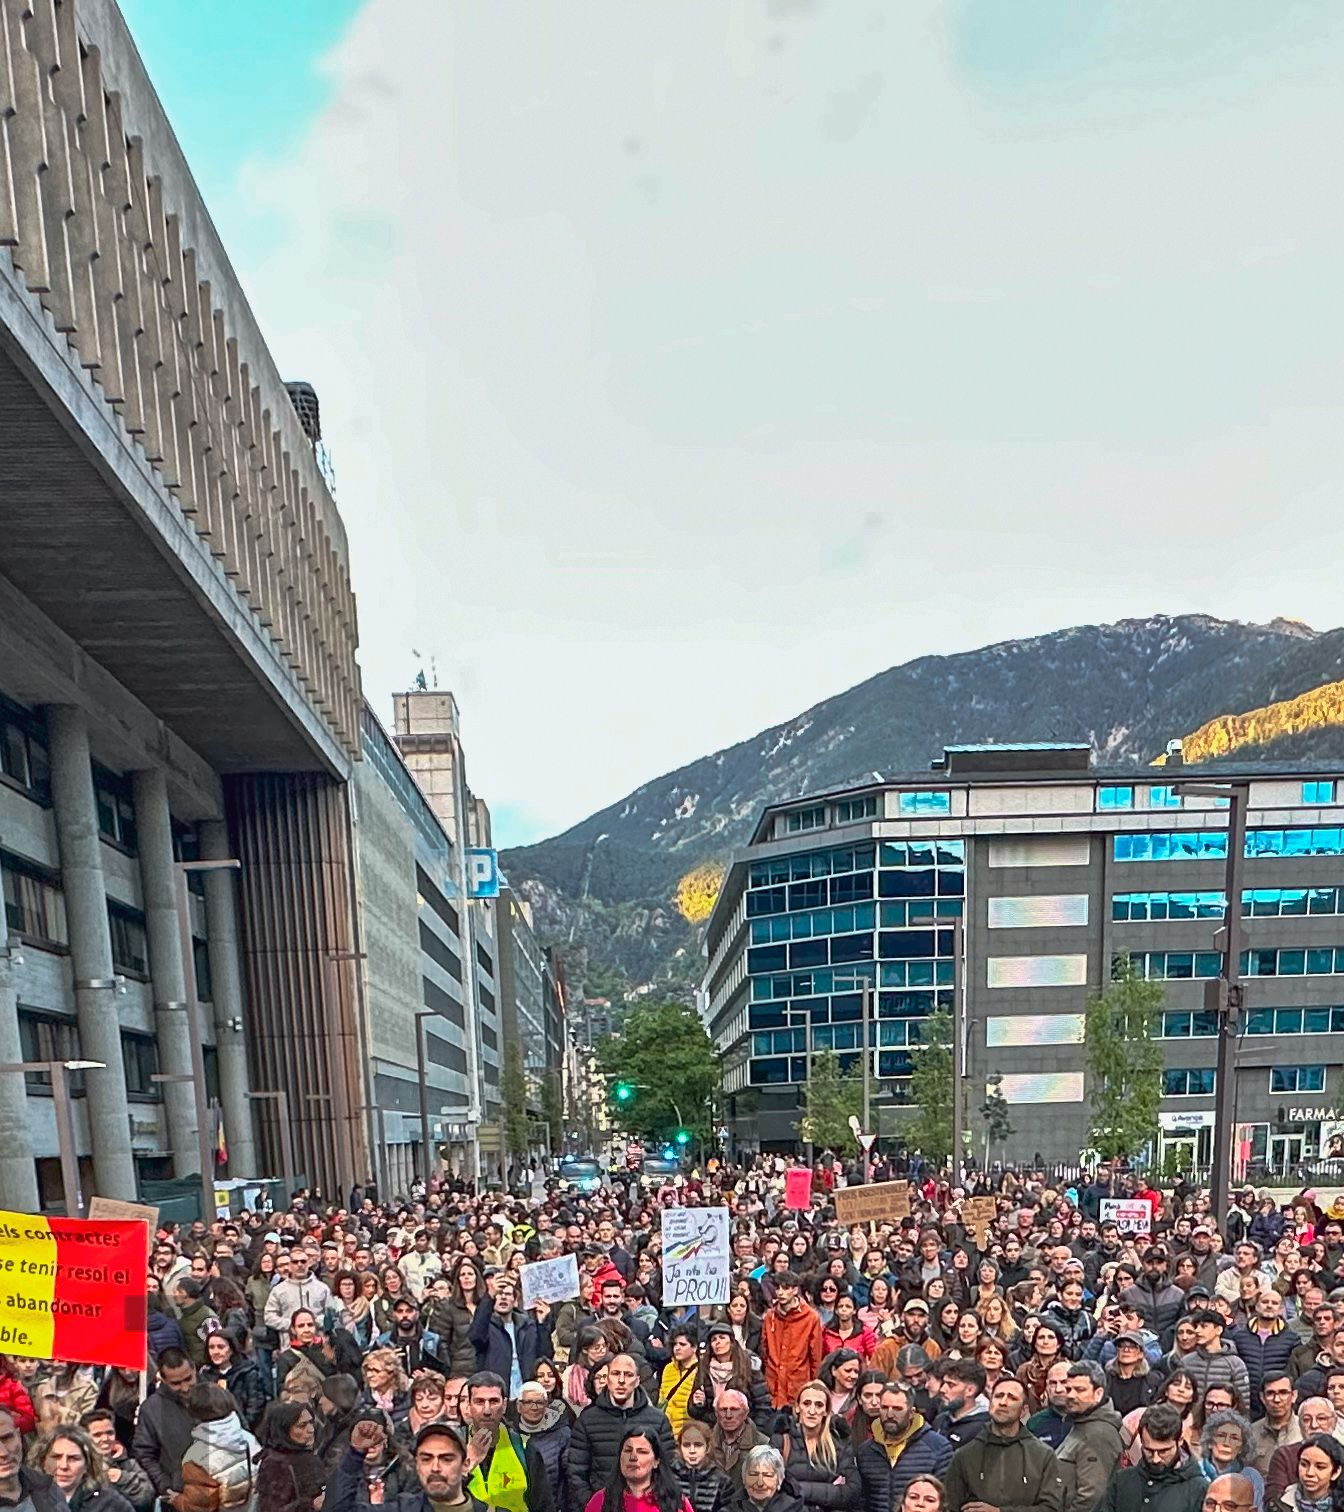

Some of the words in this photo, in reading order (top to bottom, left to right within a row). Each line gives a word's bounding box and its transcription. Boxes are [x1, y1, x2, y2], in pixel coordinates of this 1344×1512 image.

[24, 1226, 121, 1248] contractes
[20, 1259, 64, 1277] tenir
[67, 1265, 109, 1282] resol
[113, 1268, 130, 1285] el
[665, 1264, 681, 1283] Ja
[6, 1293, 103, 1318] abandonar
